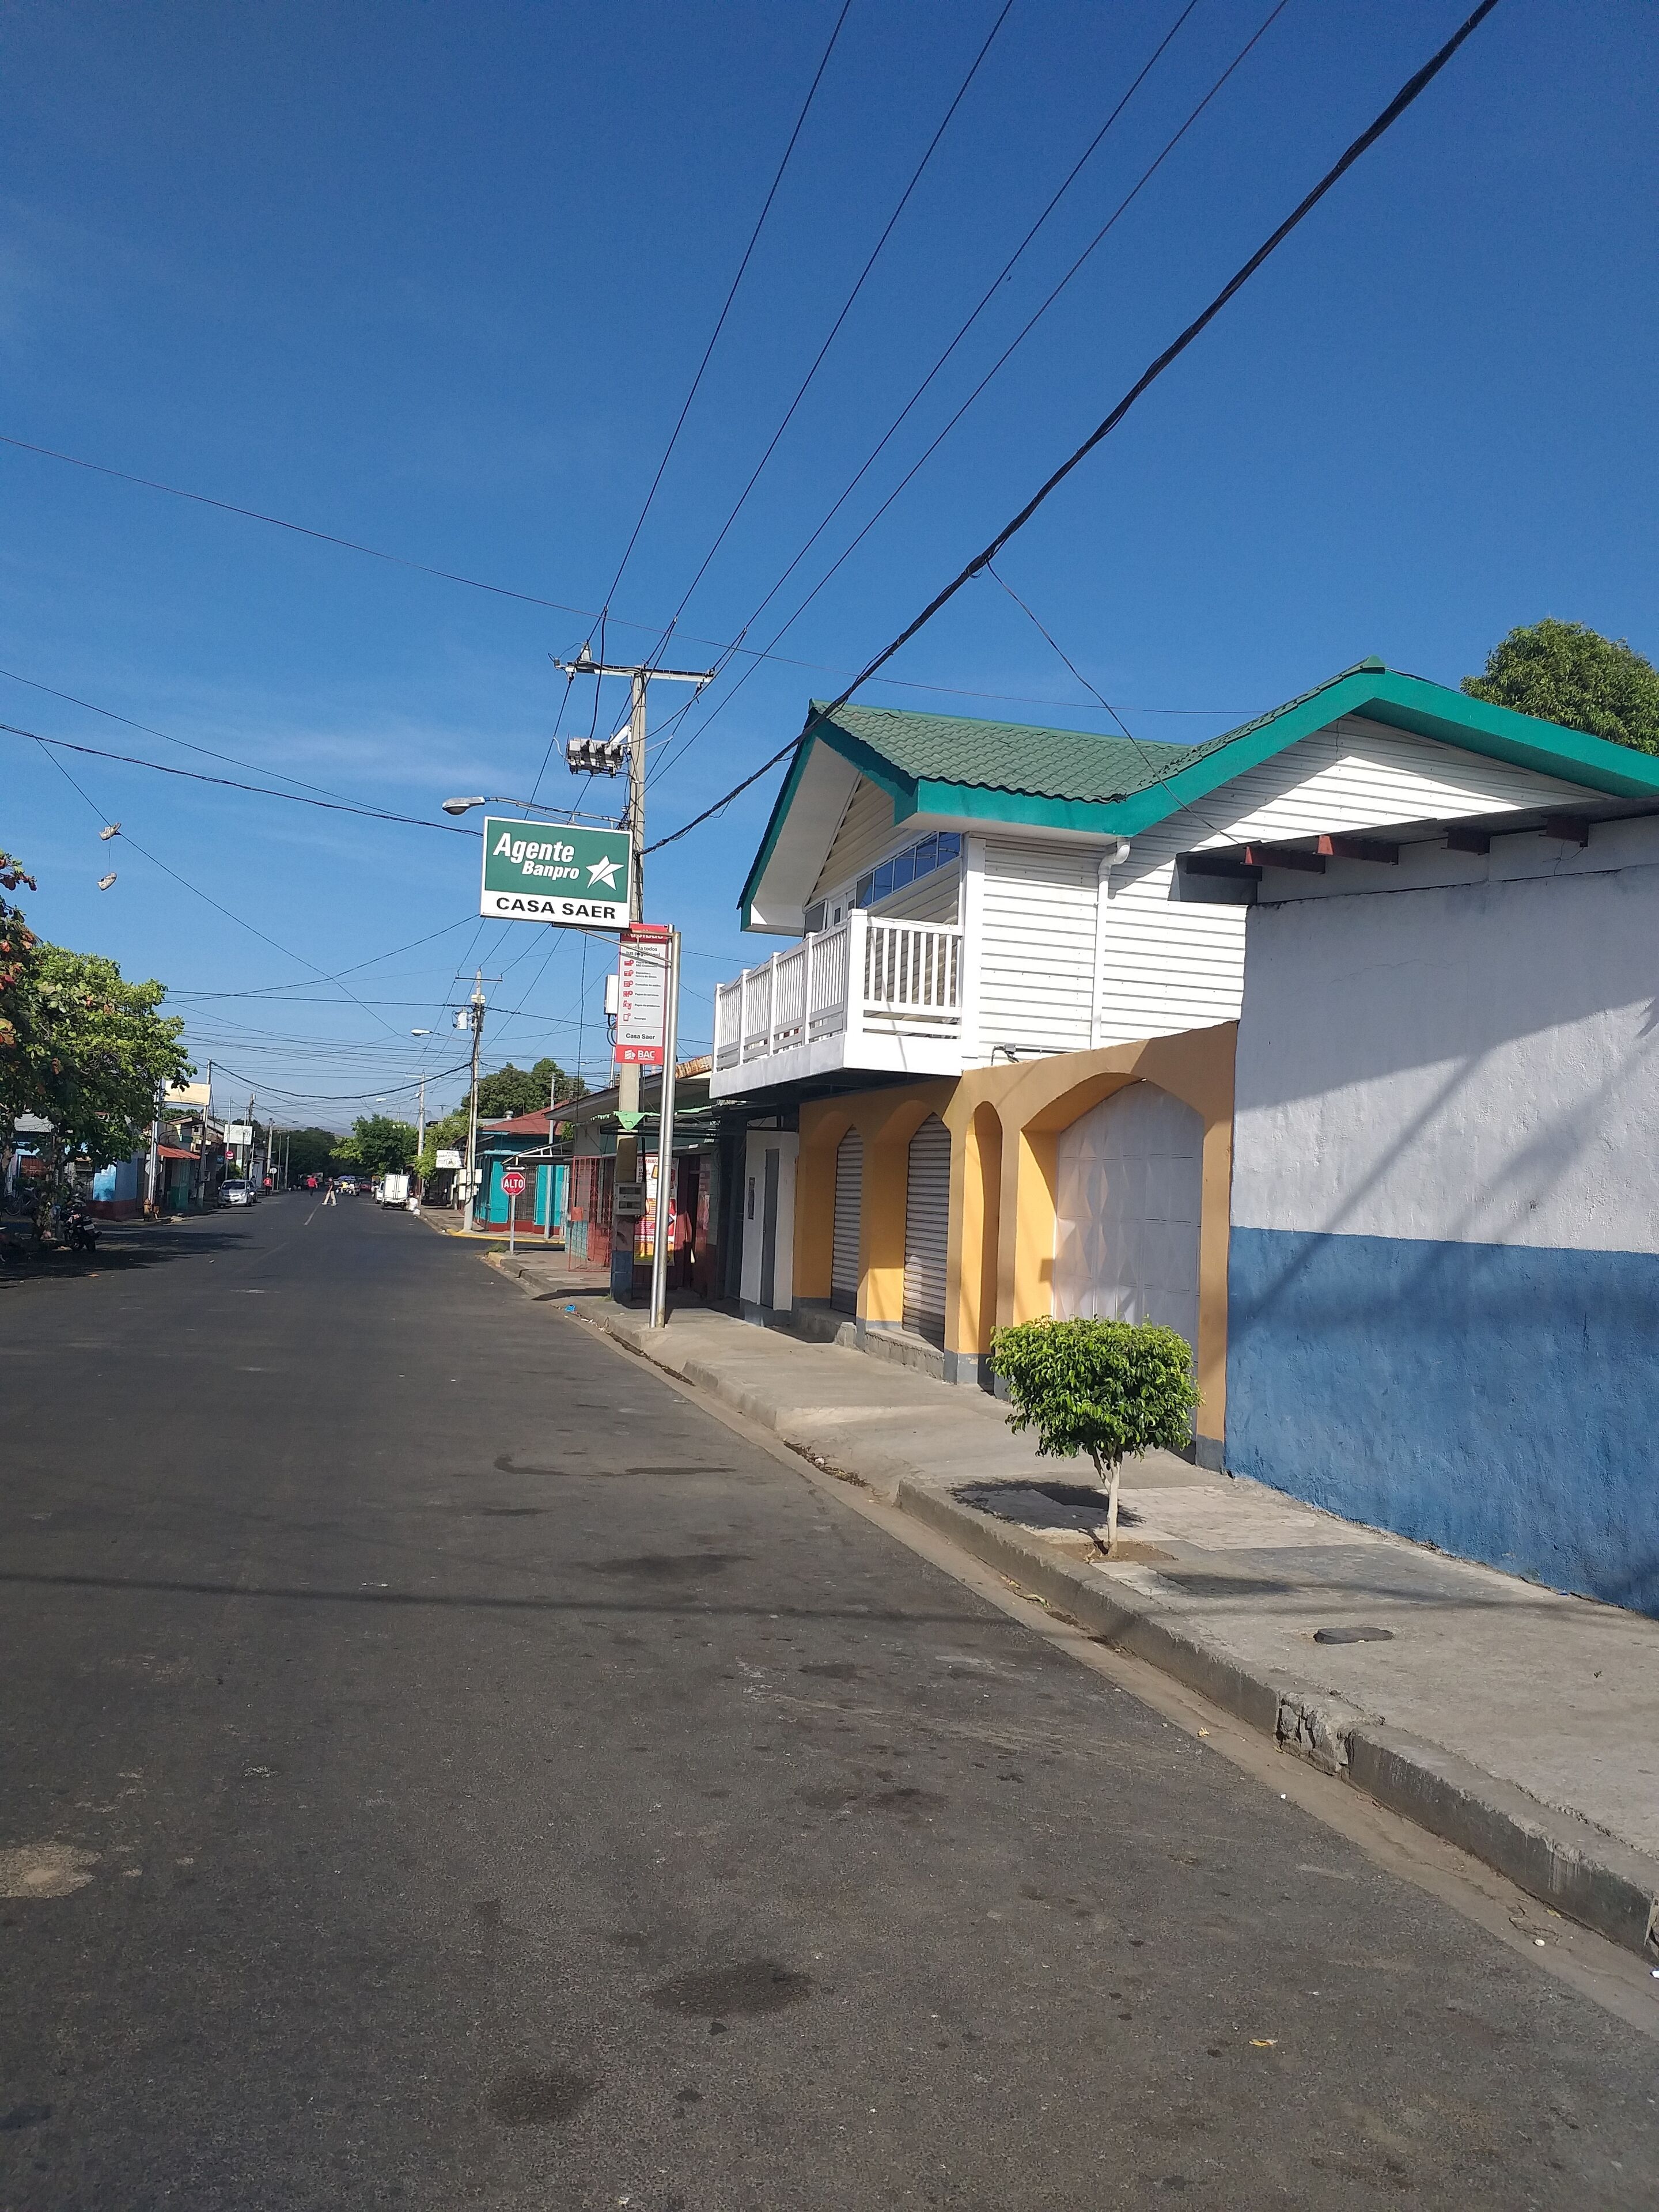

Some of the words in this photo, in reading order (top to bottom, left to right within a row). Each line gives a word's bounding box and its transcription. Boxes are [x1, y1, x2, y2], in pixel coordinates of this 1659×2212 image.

[493, 832, 574, 863] Agente
[521, 860, 580, 881] Banpro
[496, 897, 555, 914] CASA
[562, 902, 616, 919] SAER
[638, 1050, 656, 1058] BAC
[503, 1179, 524, 1188] ALTO
